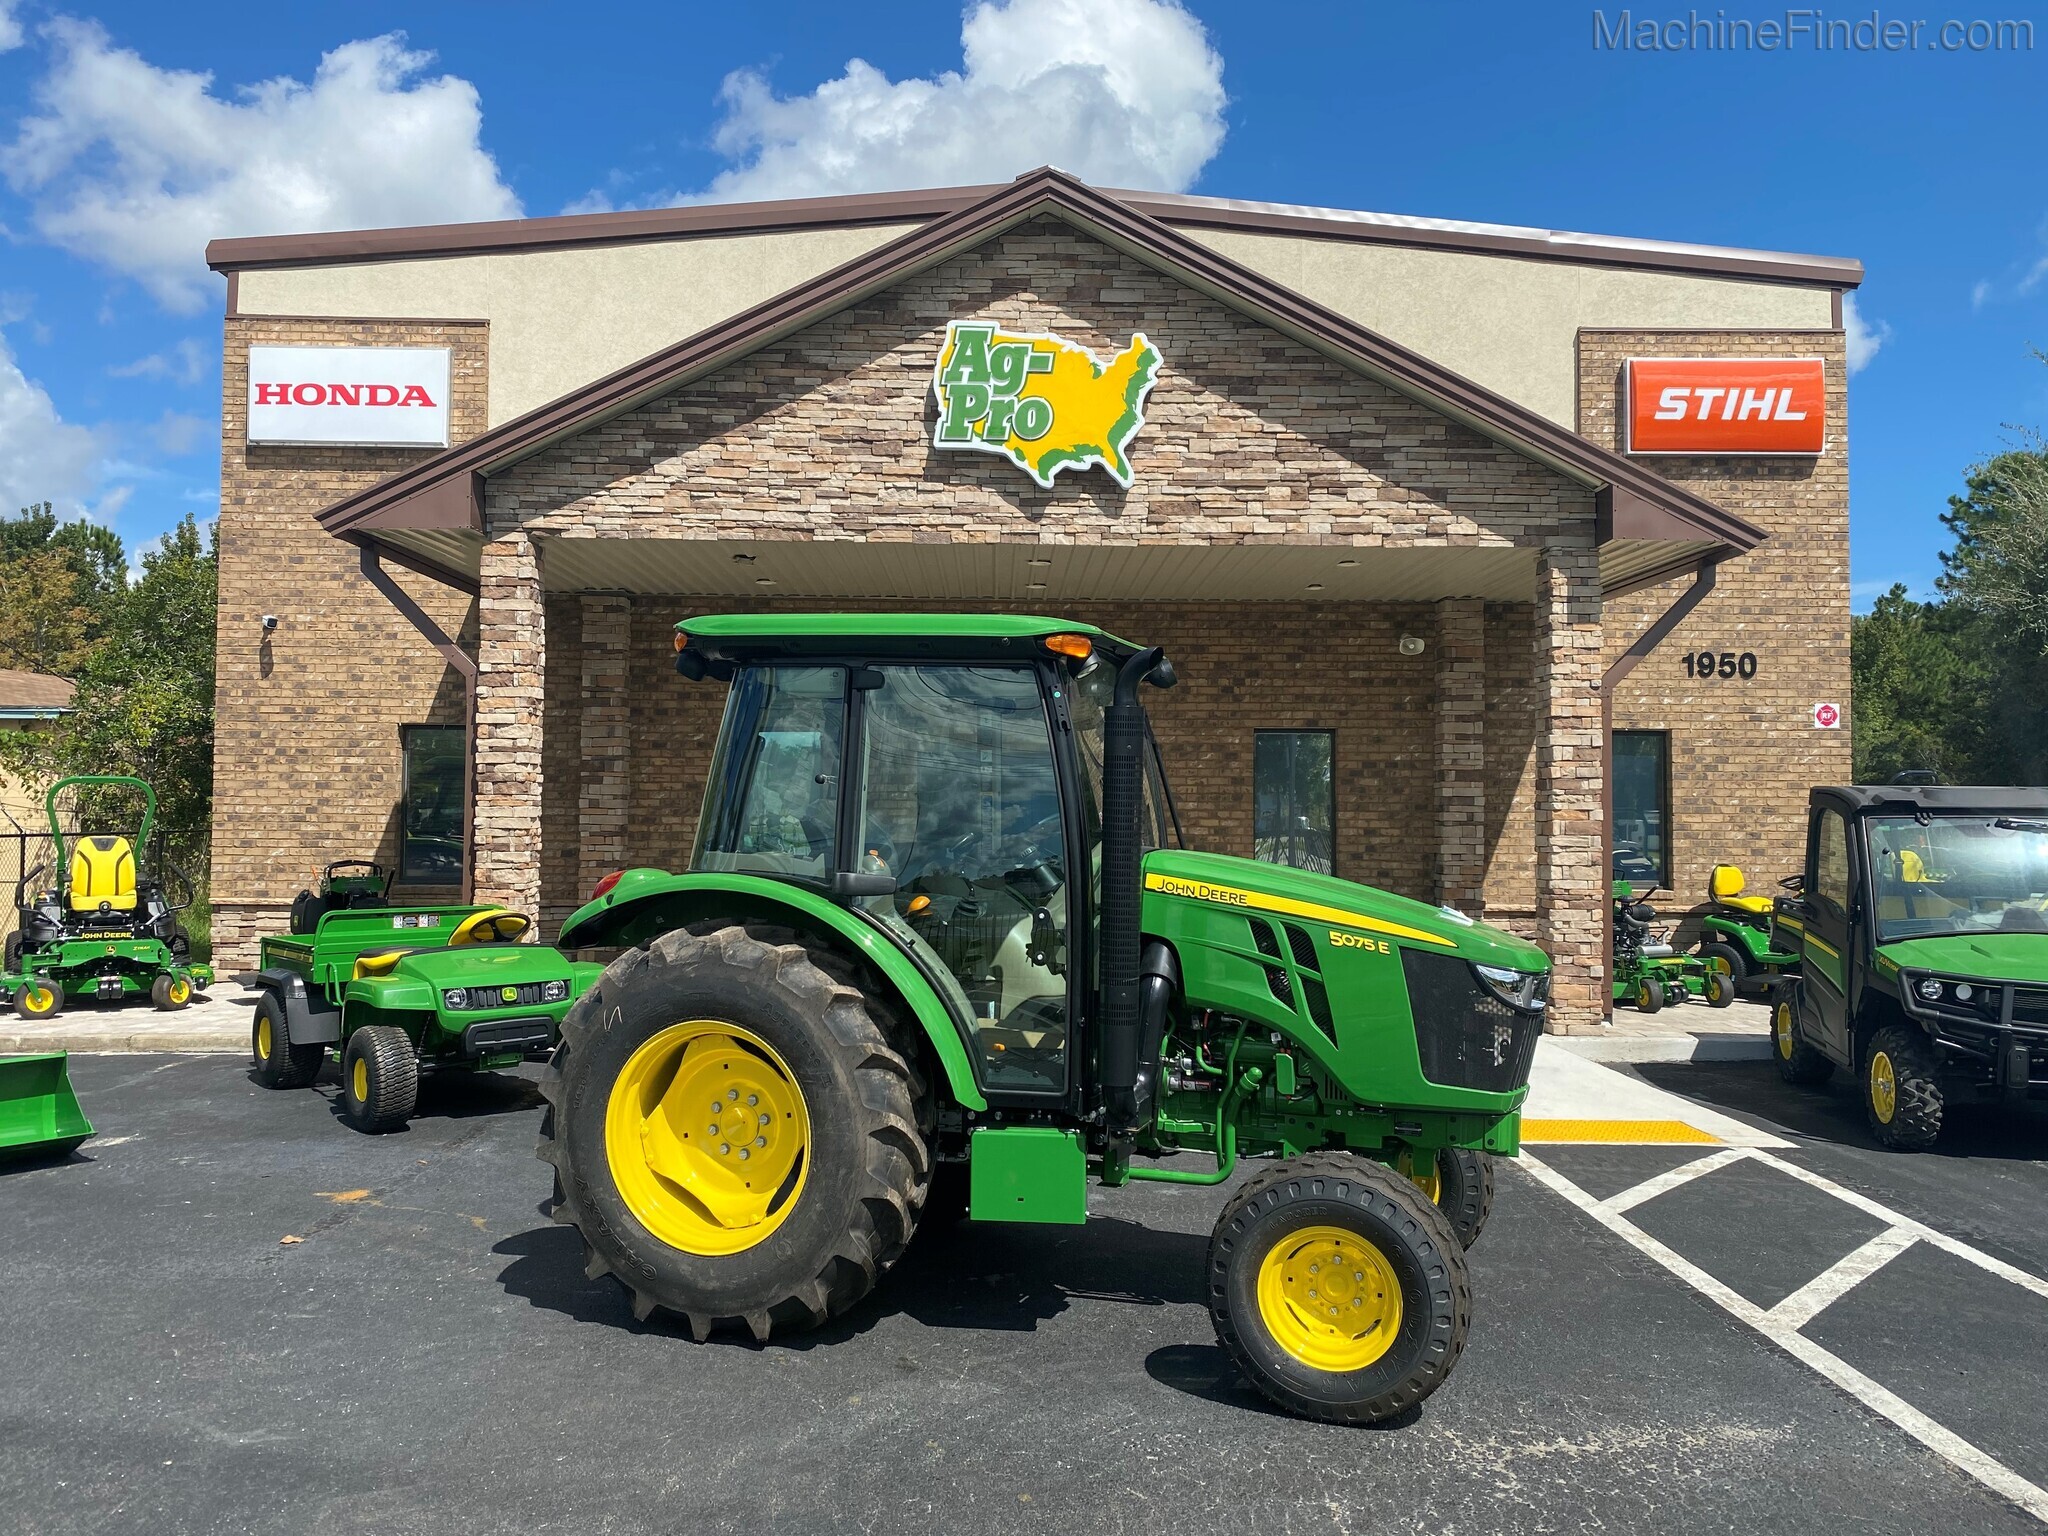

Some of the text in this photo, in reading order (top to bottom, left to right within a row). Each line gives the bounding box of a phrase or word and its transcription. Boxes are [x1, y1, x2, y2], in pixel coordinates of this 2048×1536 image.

[942, 327, 1054, 396] Ag-
[255, 383, 437, 407] HONDA
[1654, 387, 1807, 421] STIHL
[940, 384, 1053, 441] Pro
[1682, 652, 1757, 680] 1950
[1157, 878, 1248, 904] JOHN DEERE
[1329, 930, 1391, 954] 5075 E
[575, 1176, 657, 1280] GALAXY
[1321, 1244, 1424, 1394] GOODYEAR
